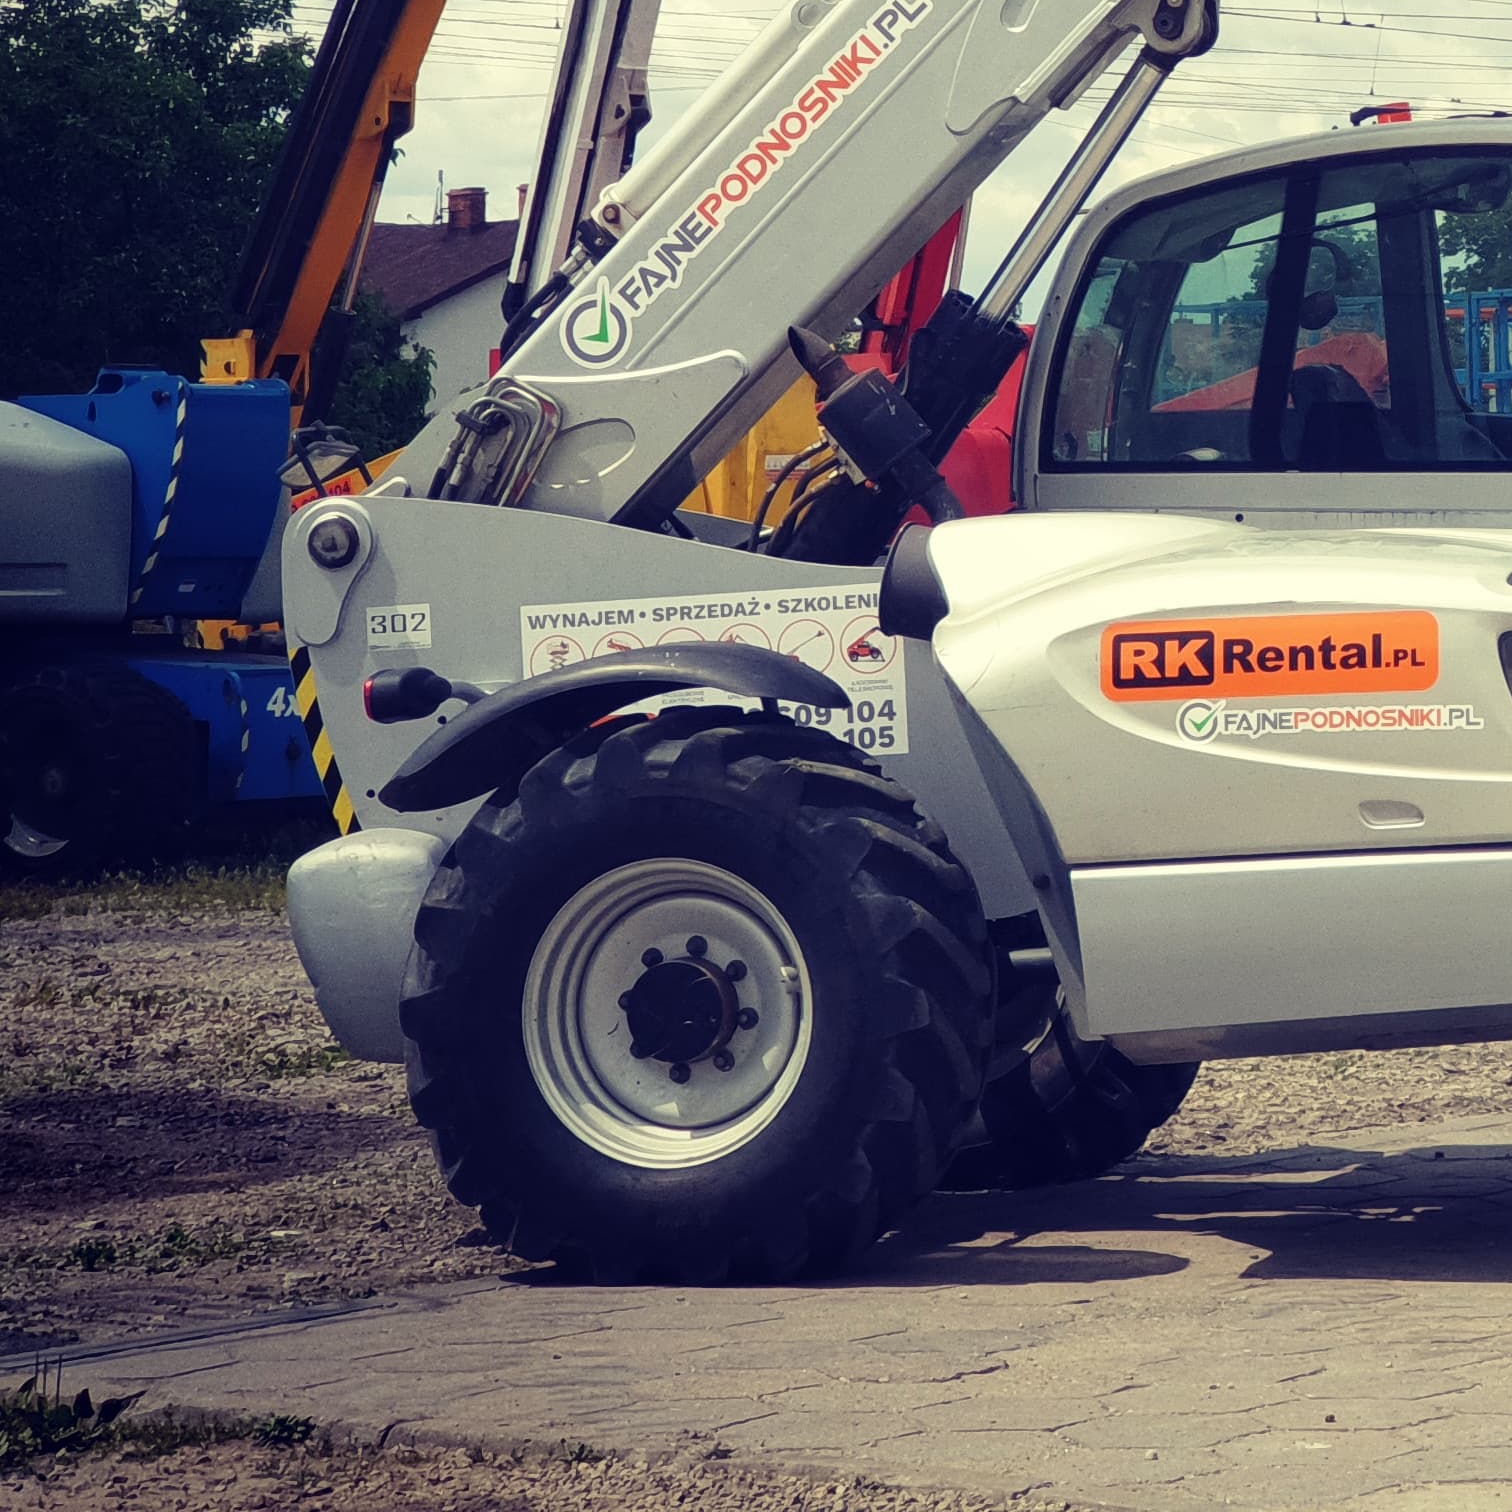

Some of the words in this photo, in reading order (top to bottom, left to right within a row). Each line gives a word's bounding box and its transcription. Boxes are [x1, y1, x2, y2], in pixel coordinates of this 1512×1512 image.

[370, 612, 427, 634] 302
[527, 609, 635, 630] WYNAJEM
[652, 596, 761, 622] SPRZEDAŻ
[777, 592, 879, 614] SZKOLENI
[1119, 637, 1209, 681] RK
[1222, 632, 1426, 674] Rental.PL
[266, 686, 302, 718] 4x
[847, 699, 897, 724] 104
[1224, 706, 1481, 735] FAJNEPODNOSNIKI.PL
[843, 725, 896, 750] 105
